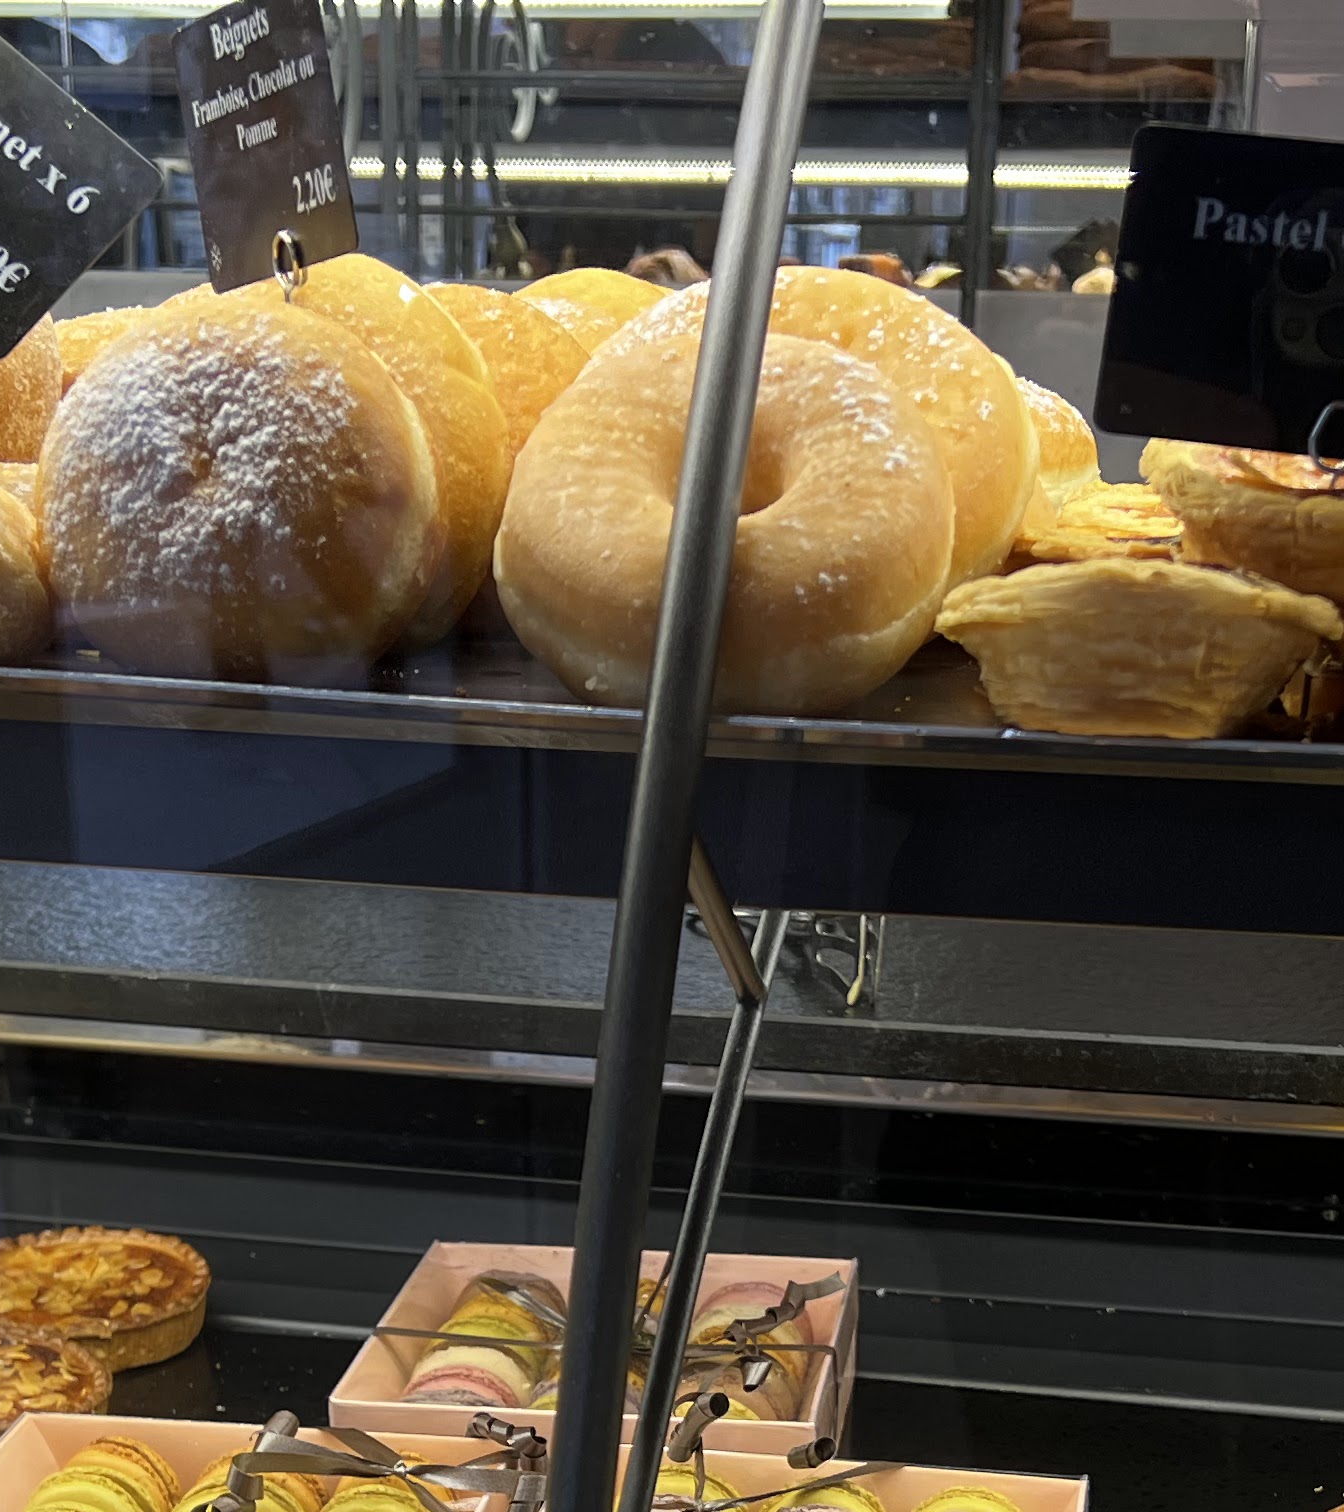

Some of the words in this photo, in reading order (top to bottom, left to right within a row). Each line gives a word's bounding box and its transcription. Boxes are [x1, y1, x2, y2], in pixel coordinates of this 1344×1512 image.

[209, 7, 270, 61] Beignets
[191, 83, 250, 128] Framboise,
[248, 58, 298, 102] Chocolat
[299, 53, 316, 79] ou
[236, 117, 279, 150] Pomme
[36, 164, 68, 195] x
[66, 185, 101, 214] 6
[292, 163, 337, 216] 2,20€
[1192, 196, 1328, 253] Pastel
